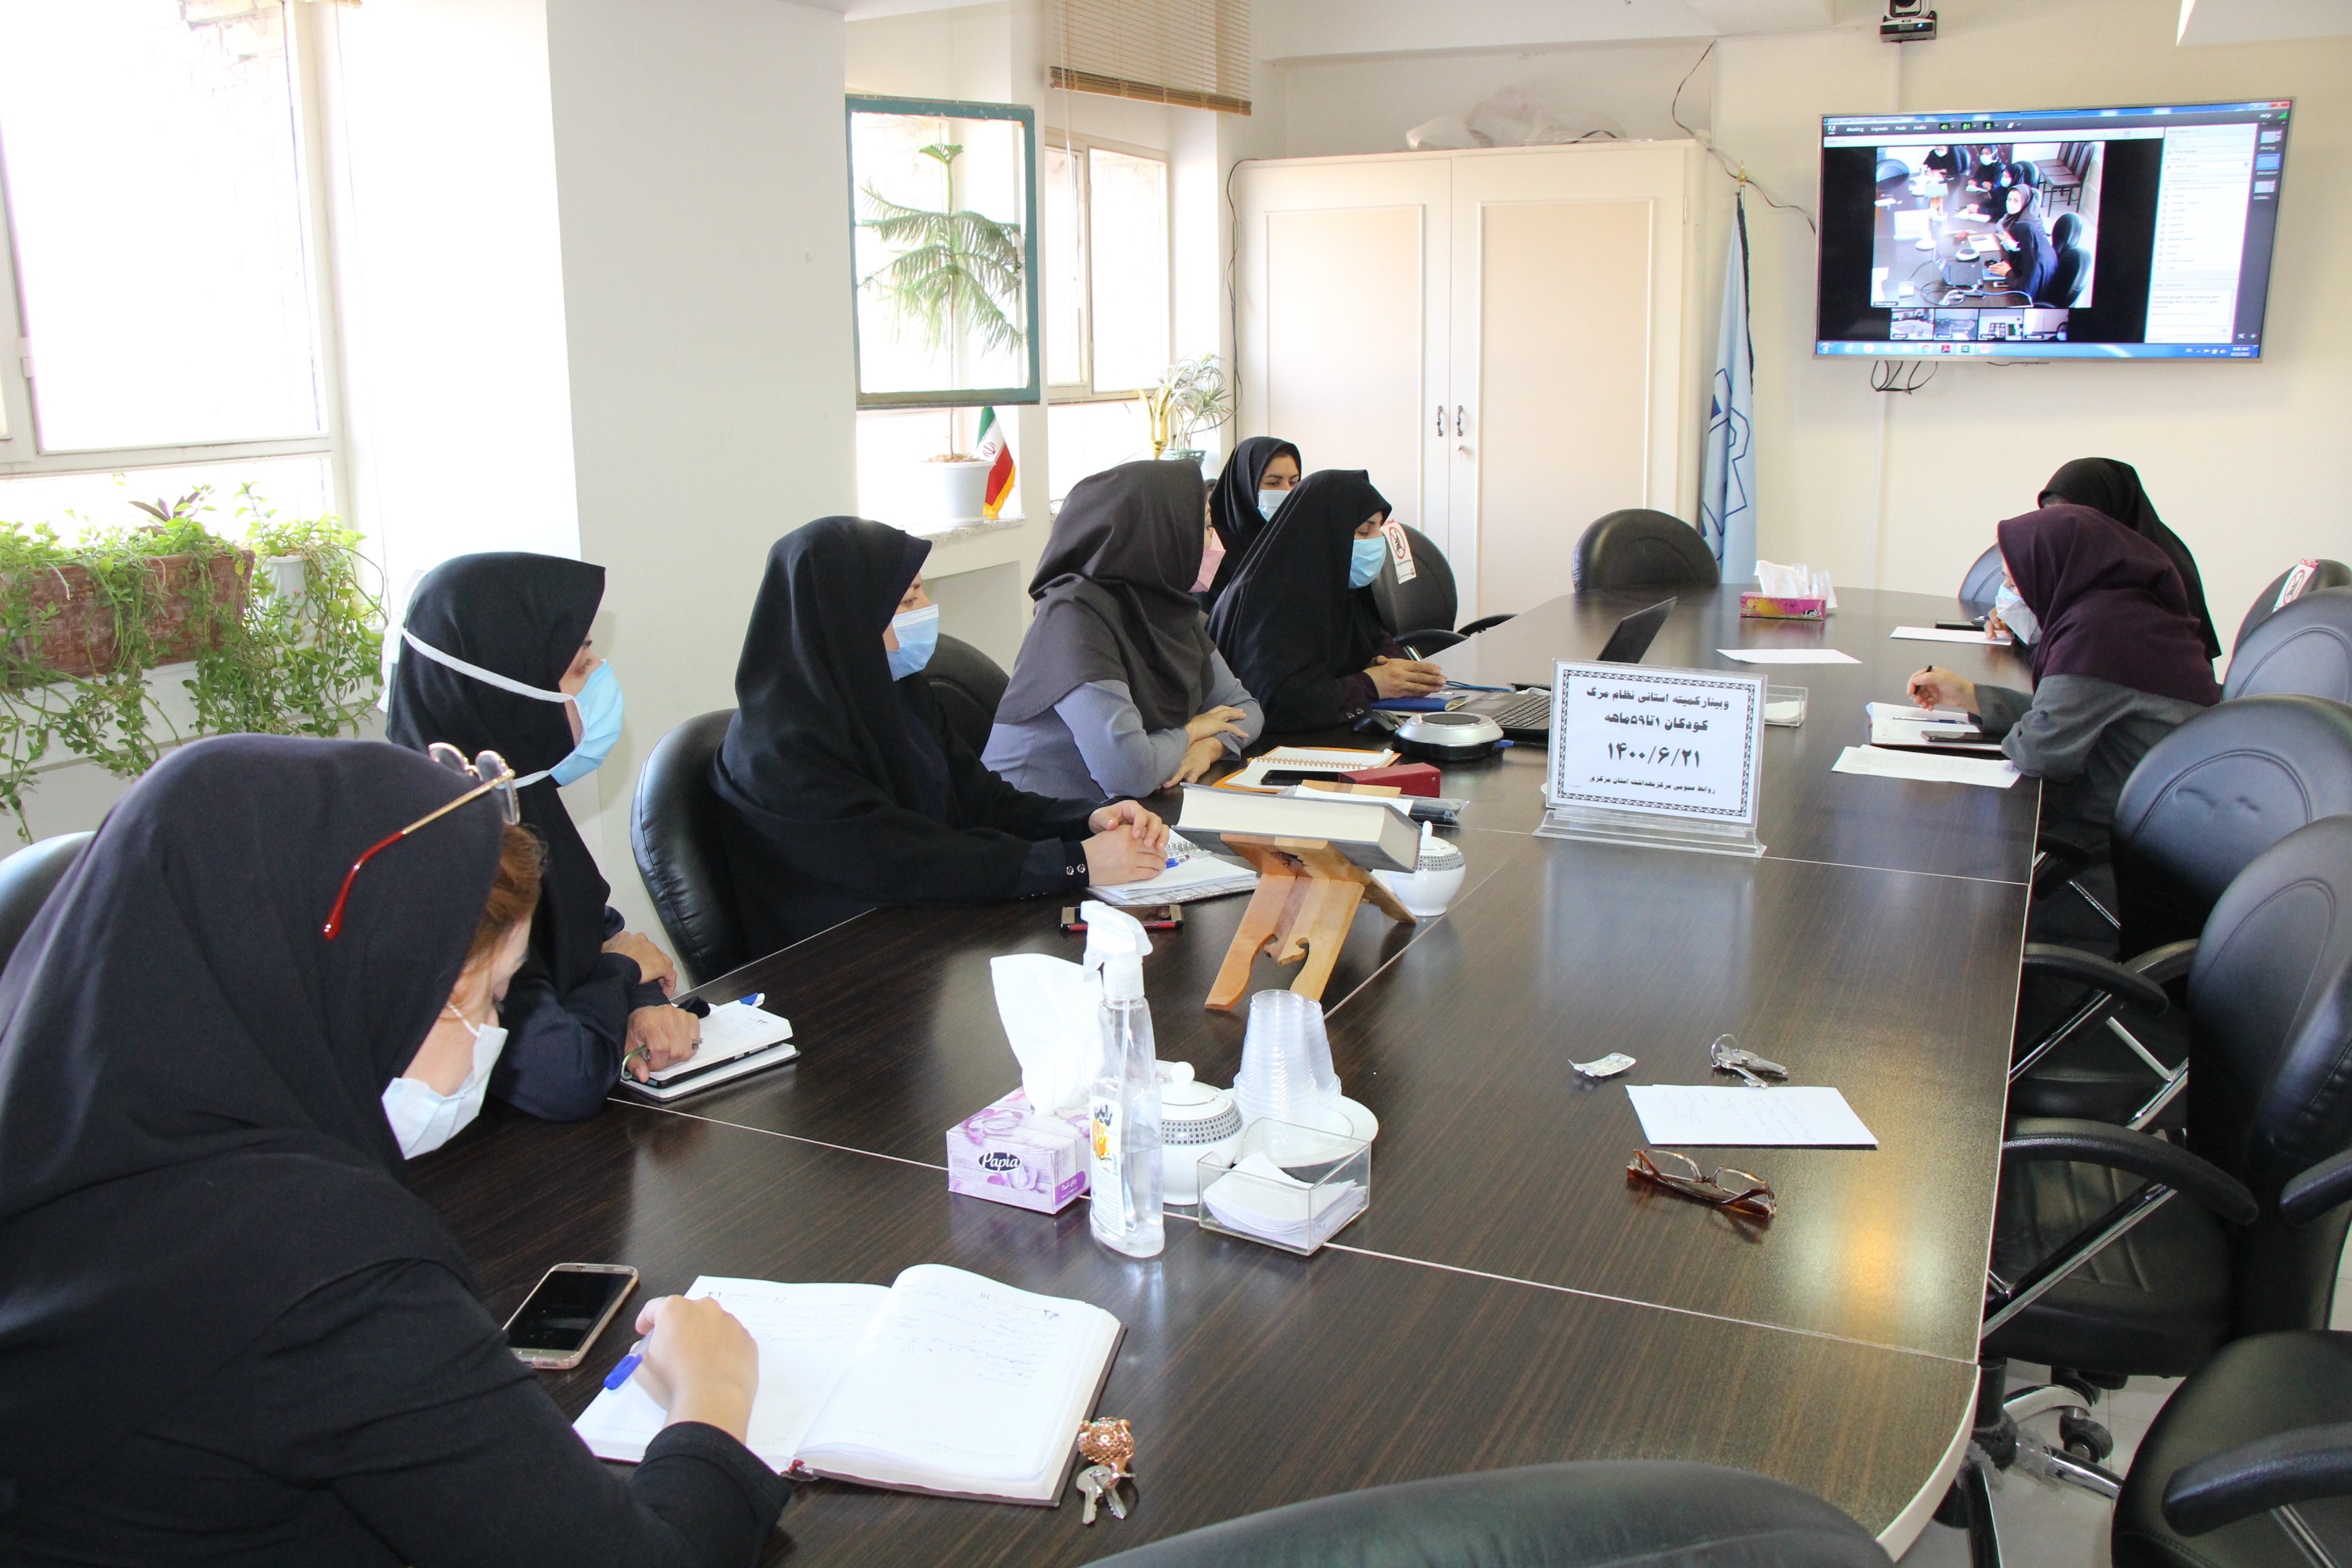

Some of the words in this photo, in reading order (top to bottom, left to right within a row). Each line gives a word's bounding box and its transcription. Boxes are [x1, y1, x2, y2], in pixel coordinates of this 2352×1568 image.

[1586, 687, 1609, 700] مرگ
[1612, 689, 1635, 701] نظام
[1637, 692, 1669, 704] استانی
[1664, 717, 1708, 733] کودکان
[1589, 775, 1611, 784] مرکزی
[981, 1152, 1019, 1171] Papia
